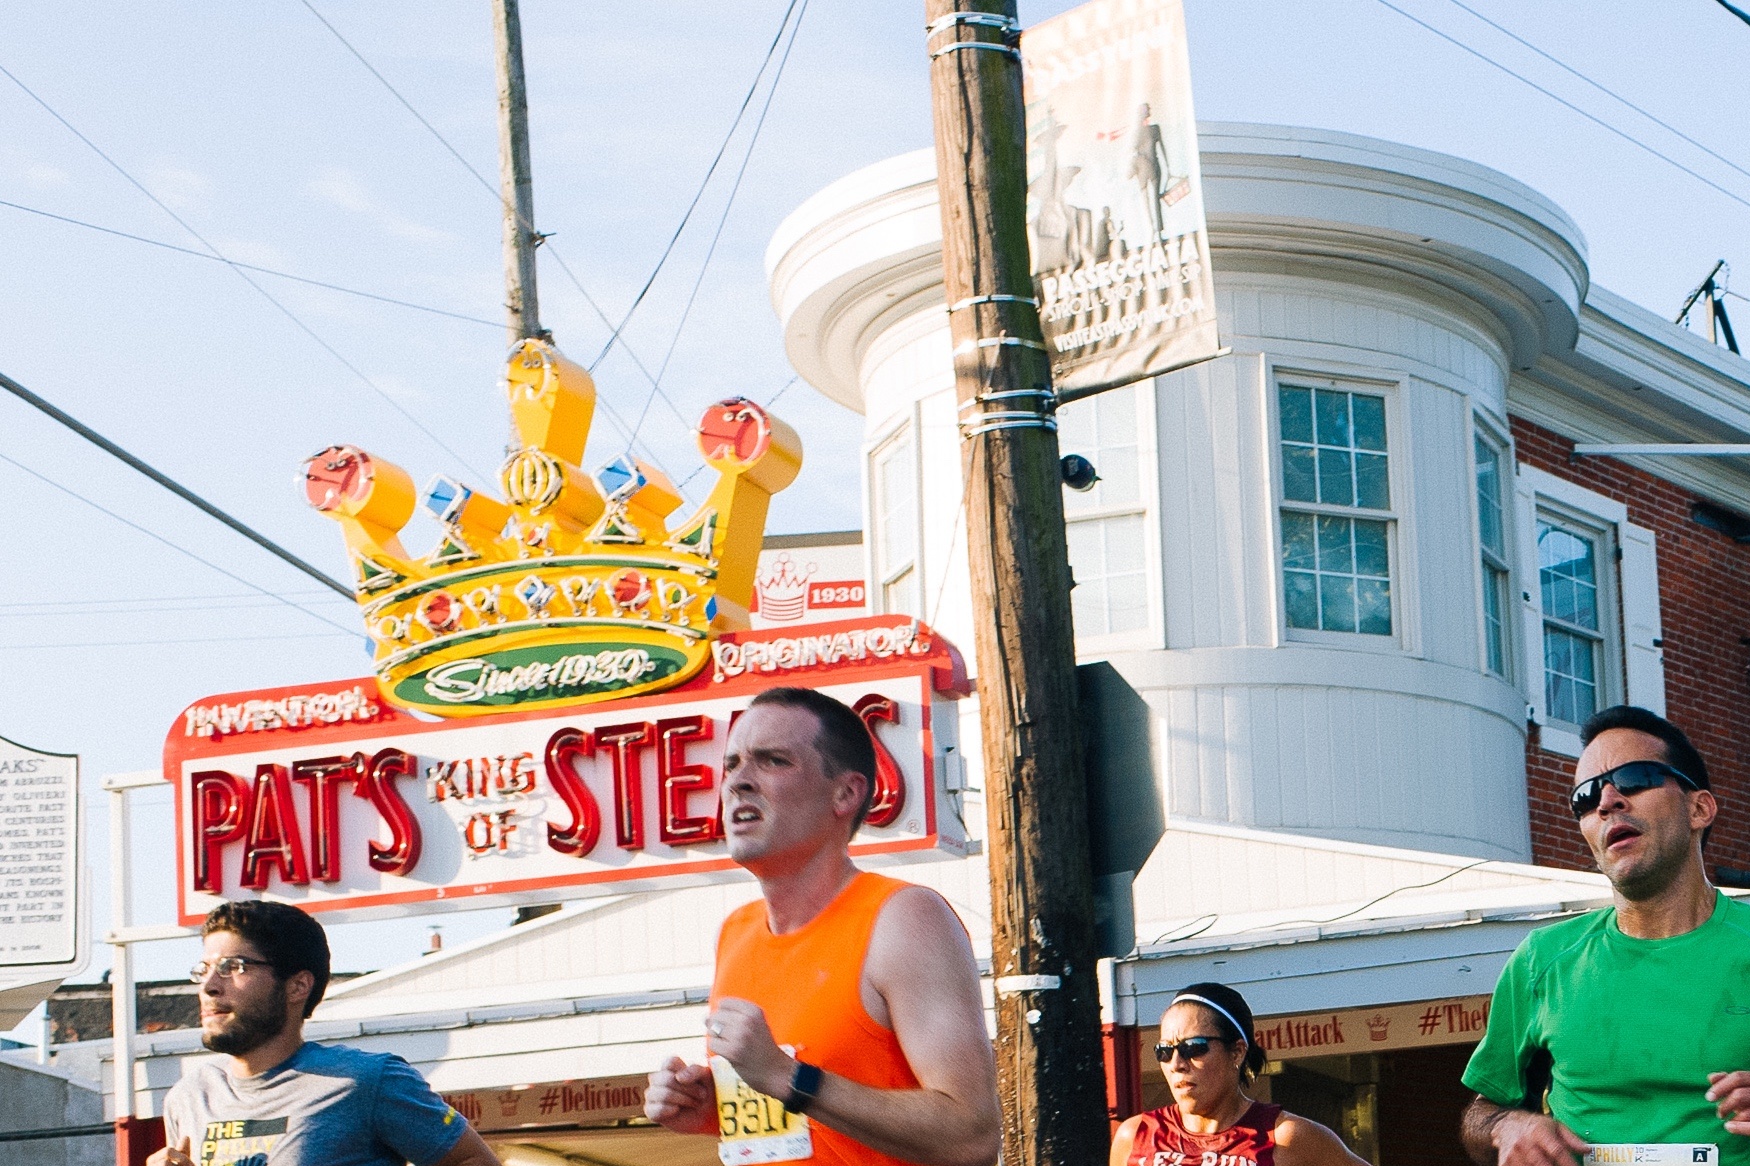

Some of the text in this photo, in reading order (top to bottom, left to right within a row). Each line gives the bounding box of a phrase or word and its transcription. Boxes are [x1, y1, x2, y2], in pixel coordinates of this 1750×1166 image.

[811, 586, 864, 604] 1930
[424, 648, 654, 703] Since 1930
[191, 693, 905, 895] PAT'S KING STES
[464, 809, 518, 857] OF
[538, 1083, 641, 1115] #Delicious
[207, 1121, 245, 1139] THE
[202, 1134, 275, 1159] PHILLY
[1595, 1147, 1634, 1162] PHILLY
